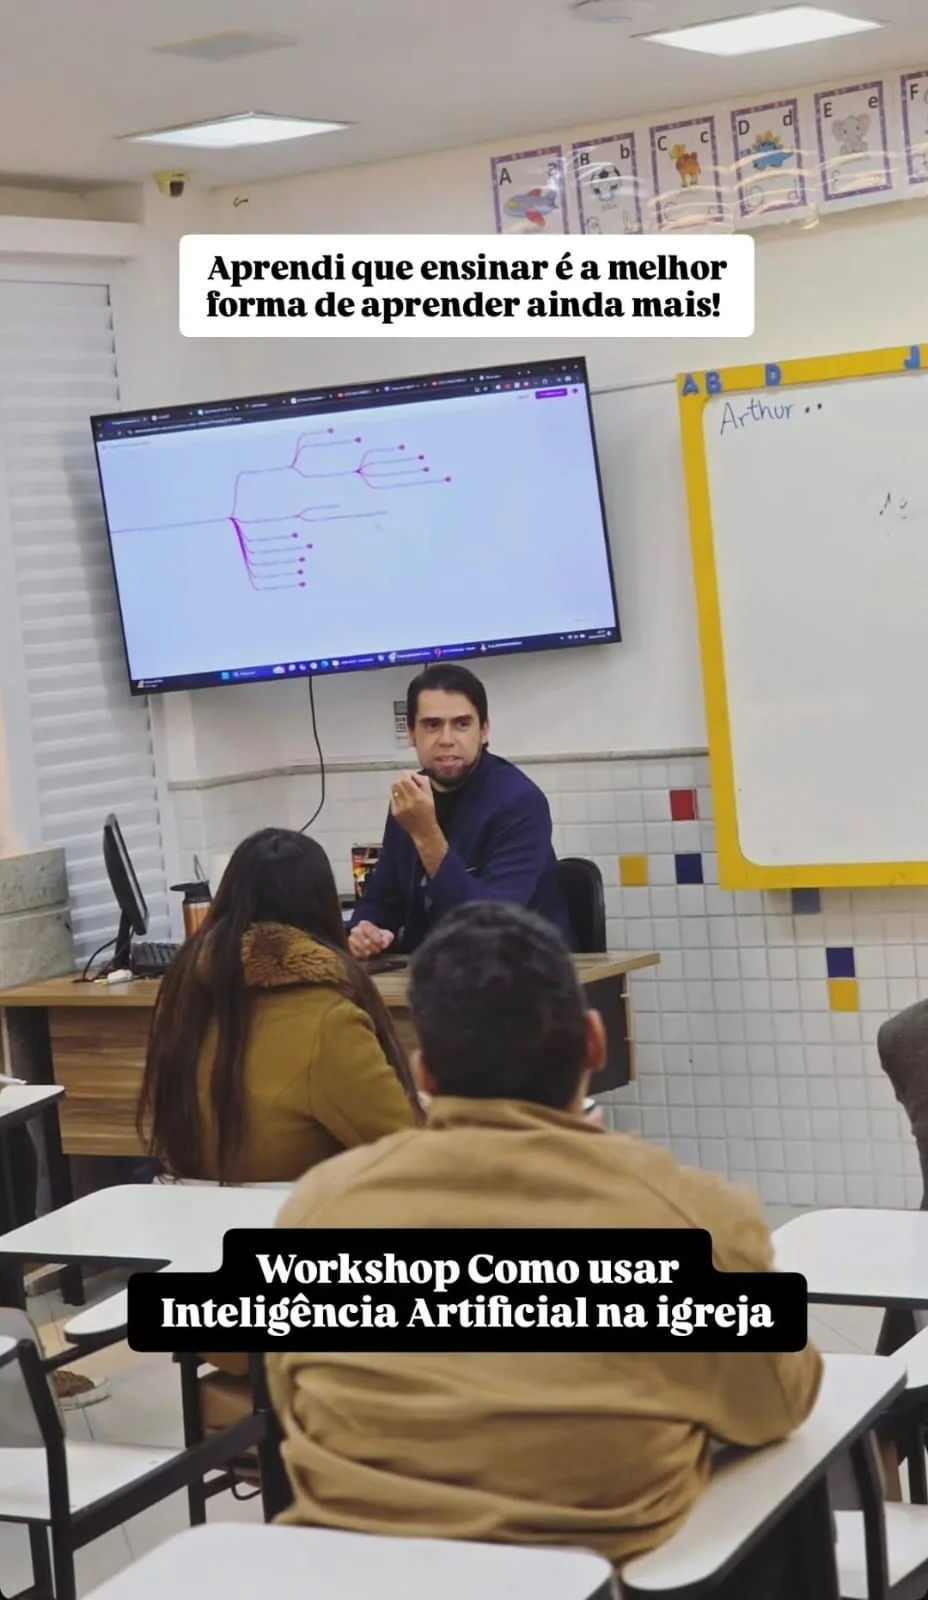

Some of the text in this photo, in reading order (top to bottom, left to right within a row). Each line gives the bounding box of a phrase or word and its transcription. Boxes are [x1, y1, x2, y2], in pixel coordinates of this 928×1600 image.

[909, 84, 919, 101] F
[824, 96, 878, 118] E e
[738, 110, 793, 135] D d
[657, 136, 668, 151] C
[580, 144, 630, 166] B b
[499, 168, 513, 186] A
[682, 345, 921, 396] A B D J
[720, 397, 795, 436] Arthur
